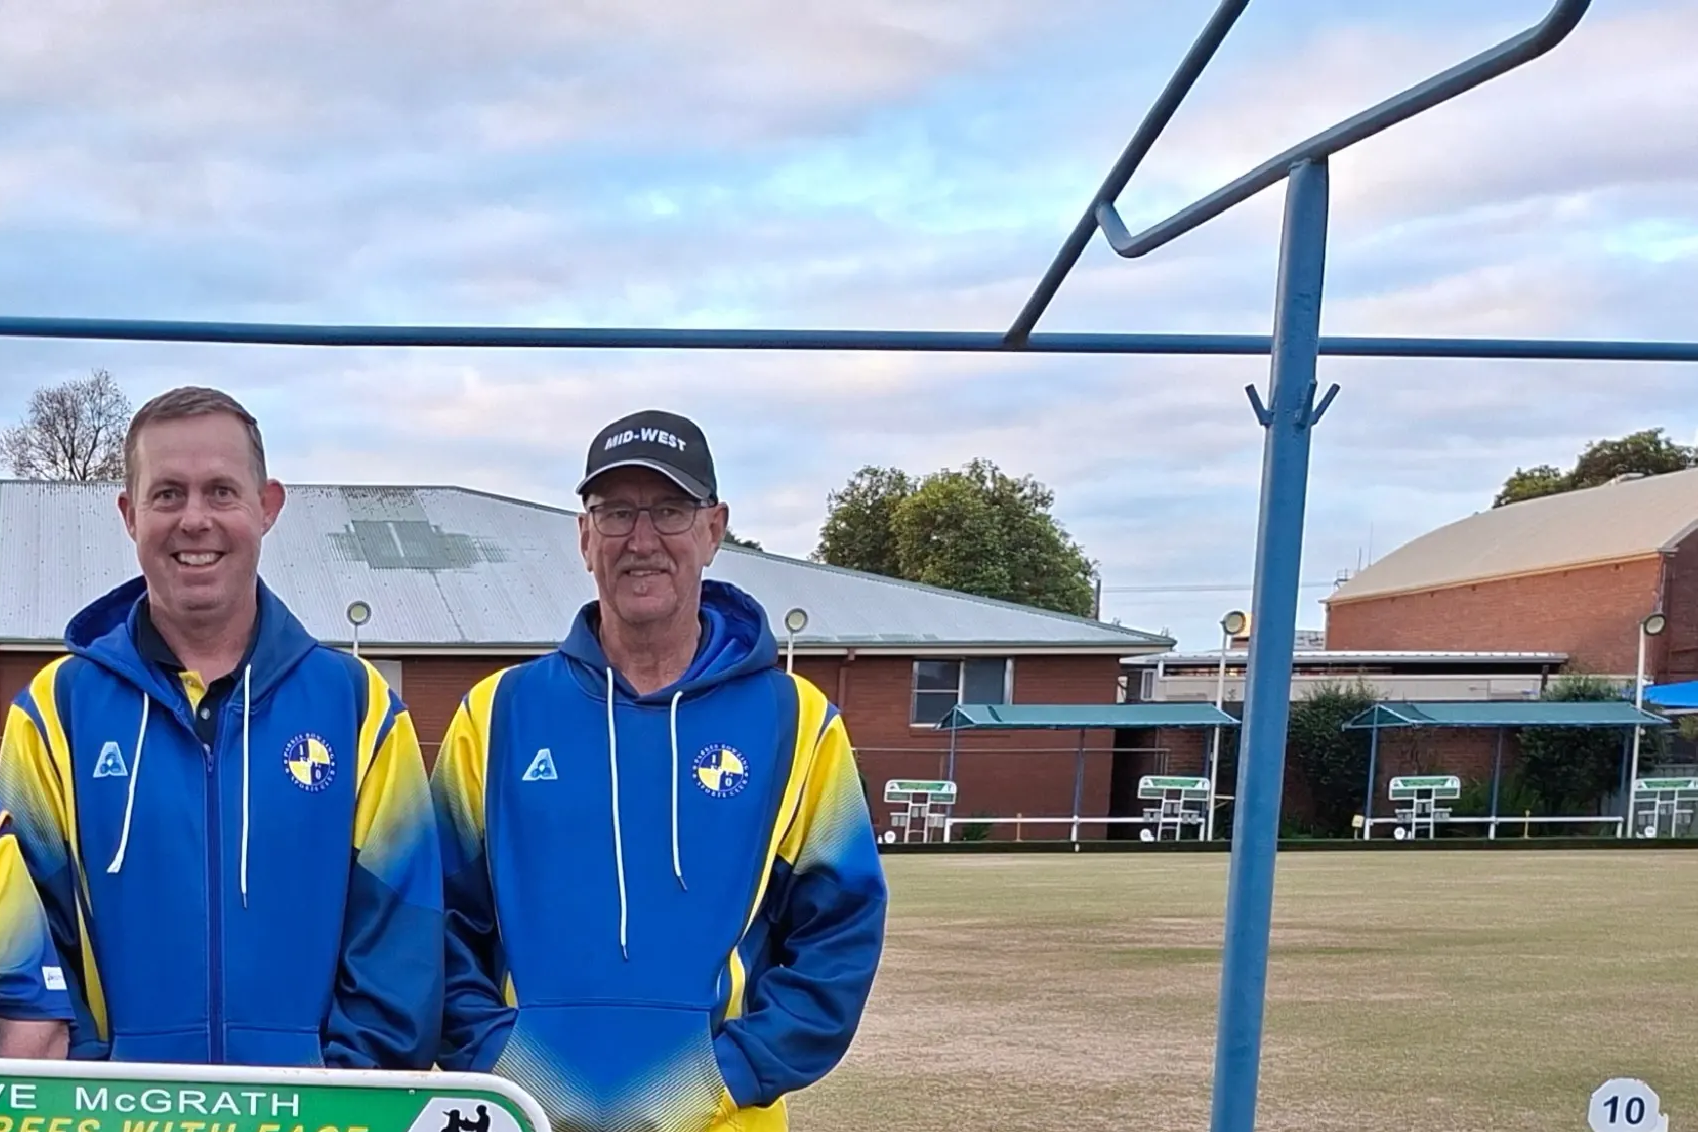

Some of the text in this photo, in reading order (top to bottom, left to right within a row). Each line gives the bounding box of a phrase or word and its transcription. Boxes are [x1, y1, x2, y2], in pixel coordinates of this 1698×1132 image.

[604, 427, 687, 452] MID-WEST
[75, 1086, 299, 1117] McGRATH
[1603, 1094, 1646, 1125] 10
